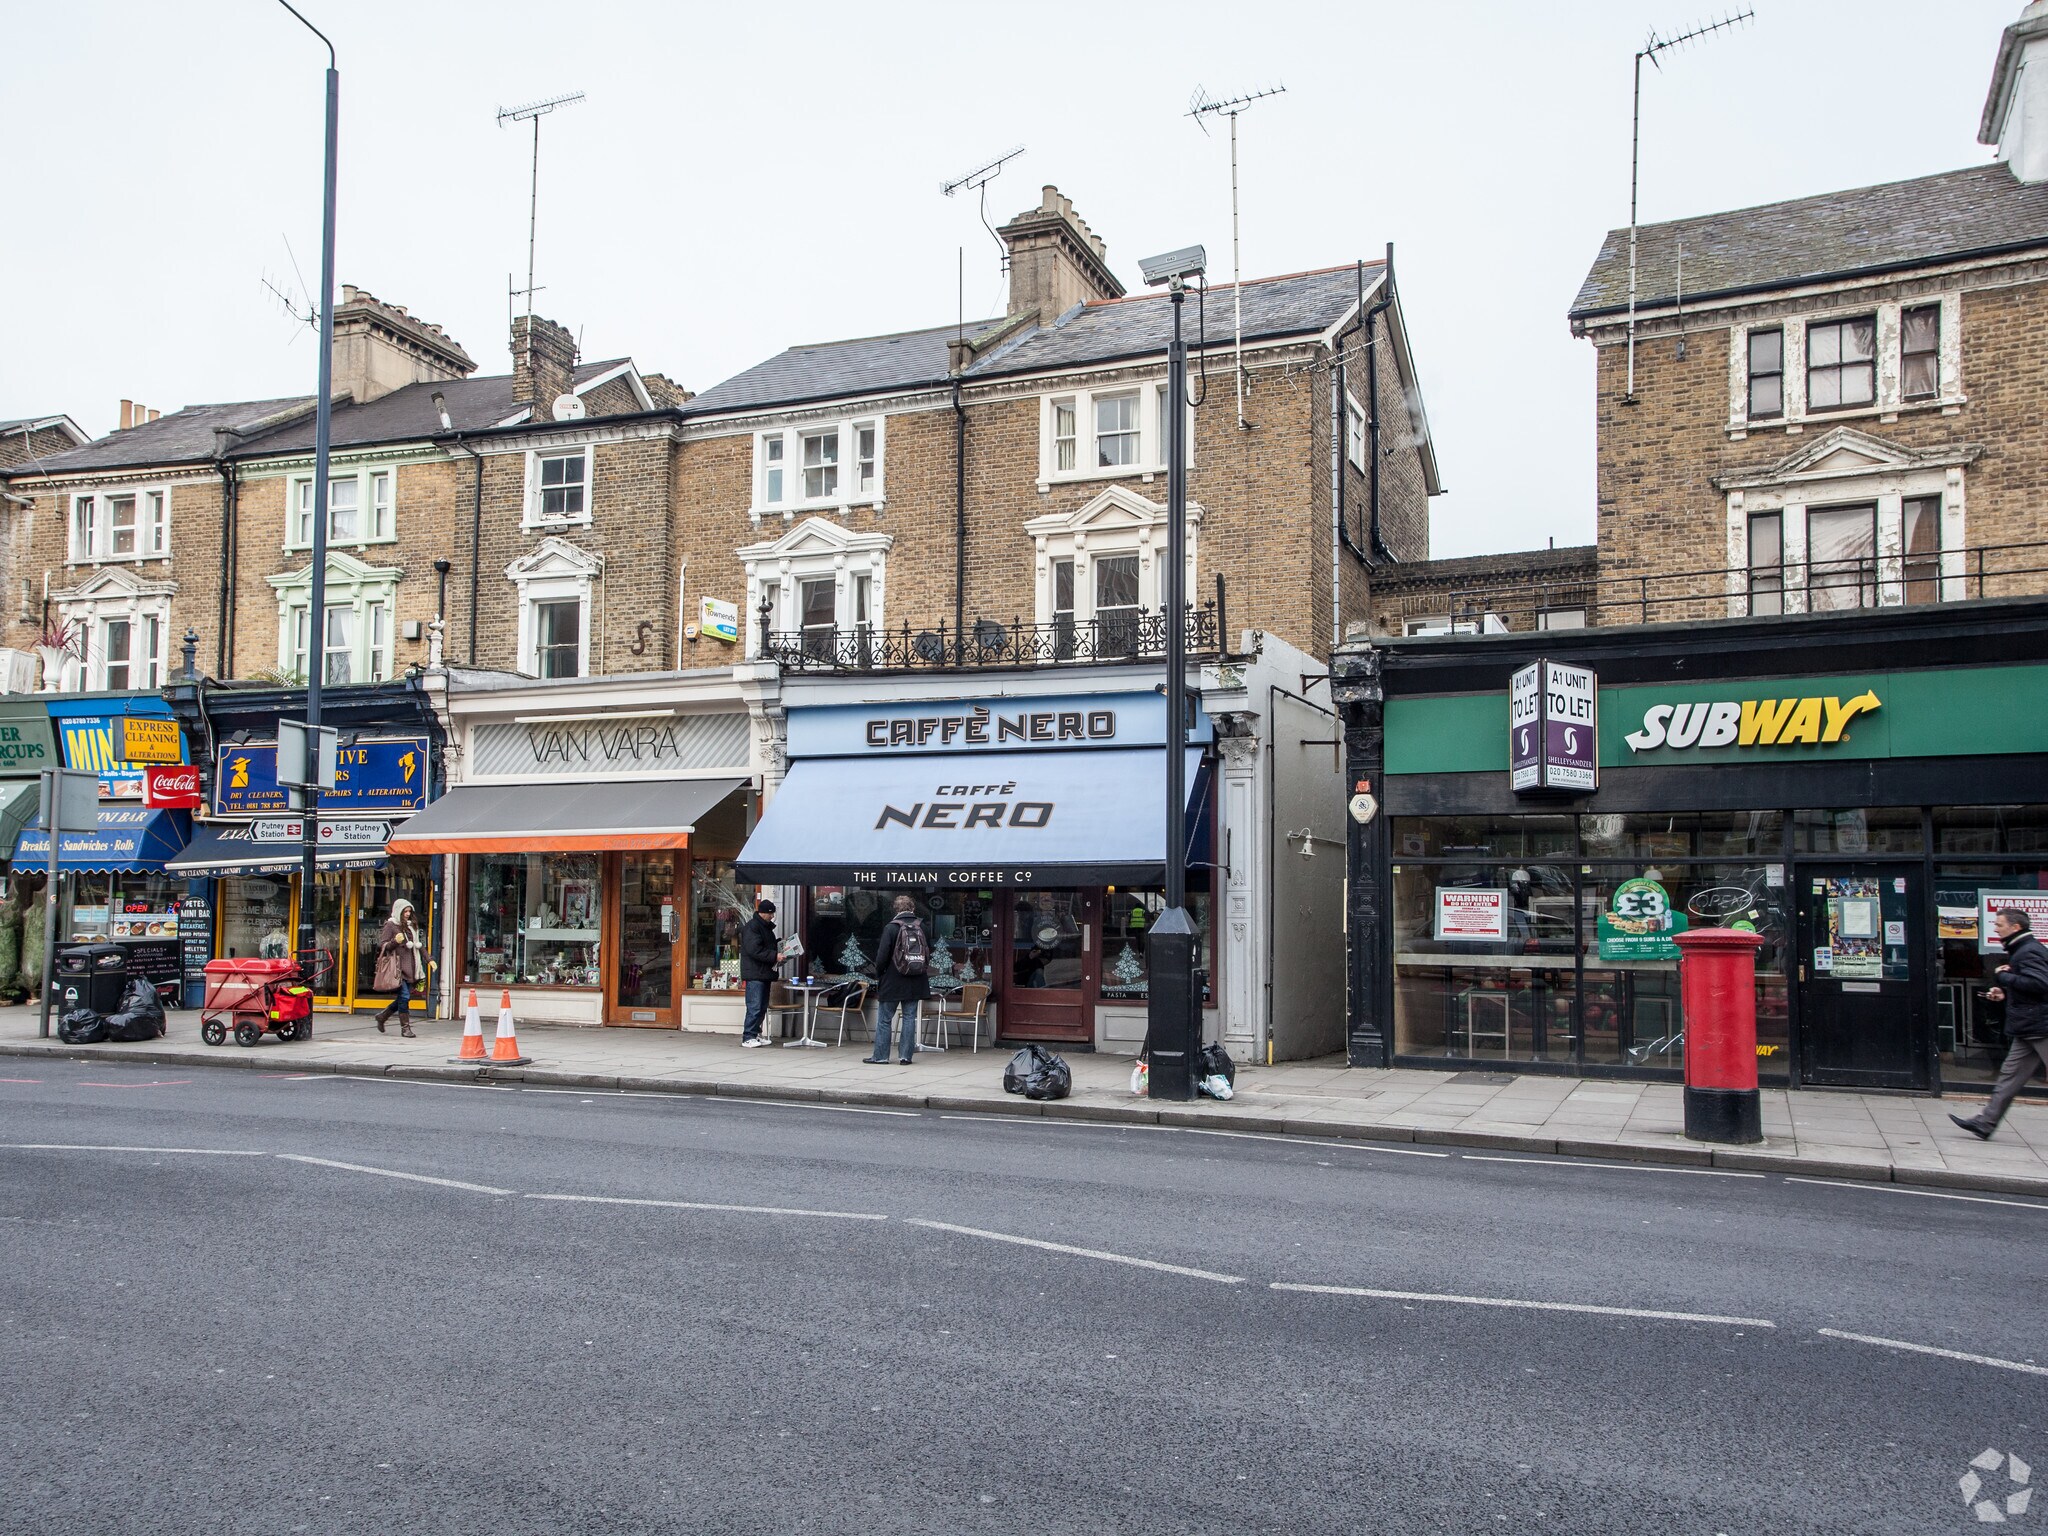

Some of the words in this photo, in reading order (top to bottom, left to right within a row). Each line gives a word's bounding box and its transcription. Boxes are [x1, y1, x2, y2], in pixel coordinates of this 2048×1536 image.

[707, 608, 736, 622] Townends
[1522, 670, 1535, 688] UNIT
[1552, 670, 1562, 685] A1
[1565, 672, 1587, 690] UNIT
[1513, 699, 1523, 720] TO
[1525, 692, 1539, 715] LET
[1548, 692, 1566, 714] TO
[1570, 696, 1592, 719] LET
[129, 721, 173, 732] EXPRESS
[866, 706, 990, 746] CAFFÈ
[997, 711, 1116, 742] NERO
[1624, 689, 1882, 753] SUBWAY
[125, 732, 178, 743] CLEANING
[149, 743, 154, 751] &
[529, 730, 591, 762] VAN
[598, 726, 683, 761] VARA
[0, 743, 45, 759] RCUPS
[129, 751, 176, 759] ALTERATIONS
[1547, 756, 1593, 768] SHELLEYSANDZER
[121, 770, 144, 778] Baguett
[1549, 767, 1560, 776] 020
[1562, 768, 1577, 778] 7580
[1579, 770, 1593, 780] 3366
[324, 789, 352, 797] REPAIRS
[357, 788, 363, 796] &
[367, 787, 413, 796] ALTERATIONS
[935, 780, 1017, 796] CAFFÈ
[118, 812, 148, 823] BAR
[873, 802, 1055, 830] NERO
[261, 822, 284, 830] Putney
[335, 824, 351, 832] East
[355, 824, 381, 833] Putney
[260, 830, 285, 838] Station
[343, 832, 371, 840] Station
[20, 840, 51, 852] Breakfa
[62, 839, 108, 852] Sandwiches
[114, 839, 134, 850] Rolls
[220, 867, 242, 875] LAUNDRY
[315, 862, 330, 870] EPAIRS
[345, 859, 377, 868] ALTERATIONS
[853, 872, 877, 883] THE
[887, 872, 938, 883] ITALIAN
[948, 871, 1004, 883] COFFEE
[1445, 895, 1498, 903] WARNING
[1616, 892, 1665, 916] £3
[1989, 899, 2048, 908] WARNIN
[125, 904, 148, 913] OPEN
[180, 909, 197, 918] MINI
[198, 909, 211, 918] BAR
[237, 905, 260, 915] SAME
